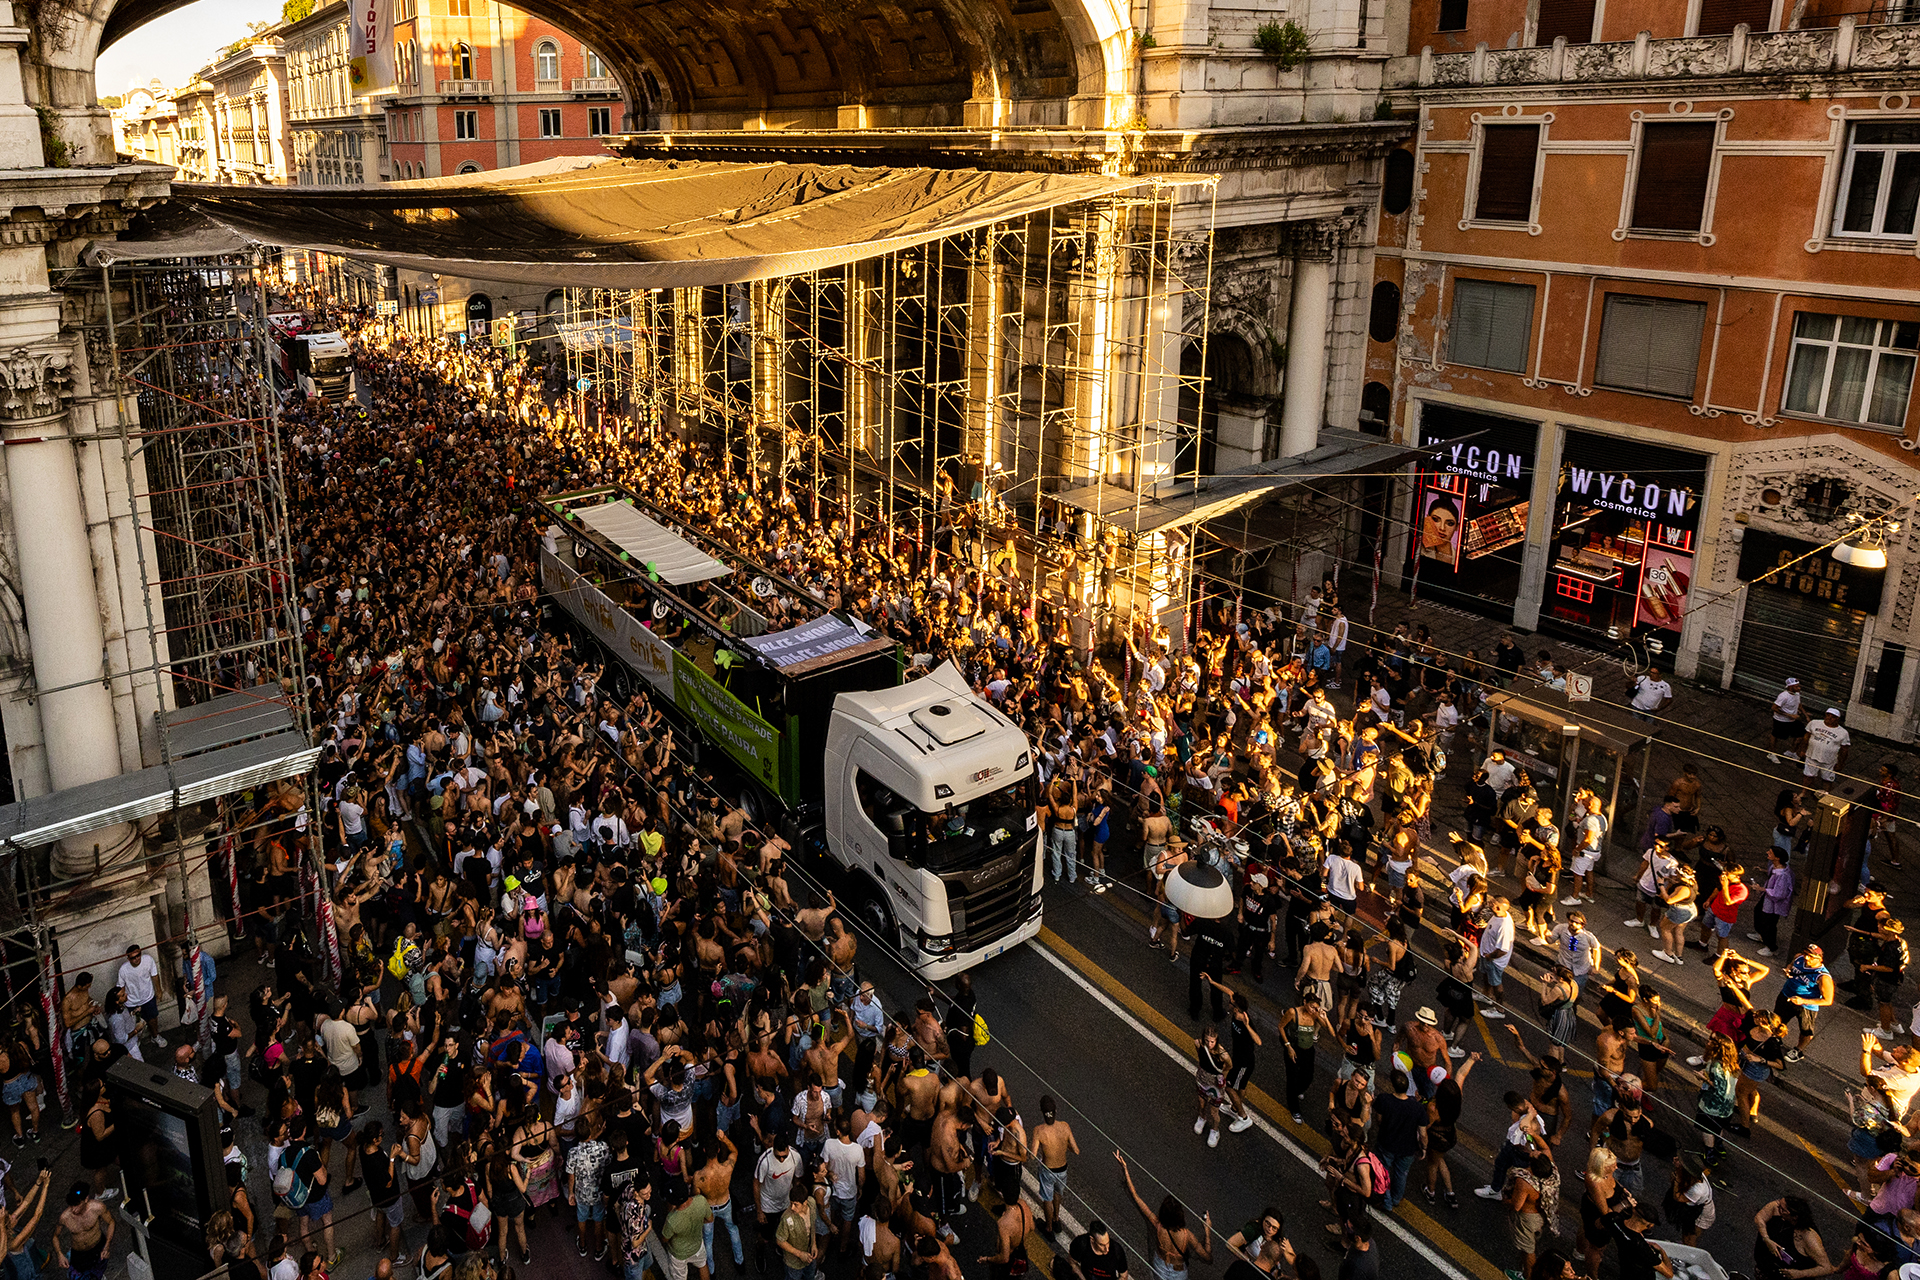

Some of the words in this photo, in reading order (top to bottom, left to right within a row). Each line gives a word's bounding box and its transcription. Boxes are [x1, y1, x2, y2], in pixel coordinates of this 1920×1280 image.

[470, 301, 486, 311] coin
[1446, 465, 1498, 482] cosmetics
[1571, 467, 1687, 516] WYCON
[1593, 499, 1656, 519] cosmetics
[1651, 570, 1667, 581] 30
[1765, 566, 1849, 603] STORE
[584, 598, 600, 621] eni
[630, 636, 650, 663] eni
[707, 692, 735, 717] DANCE
[736, 713, 773, 743] PARADE
[721, 724, 759, 759] PAURA
[1030, 816, 1035, 826] 1
